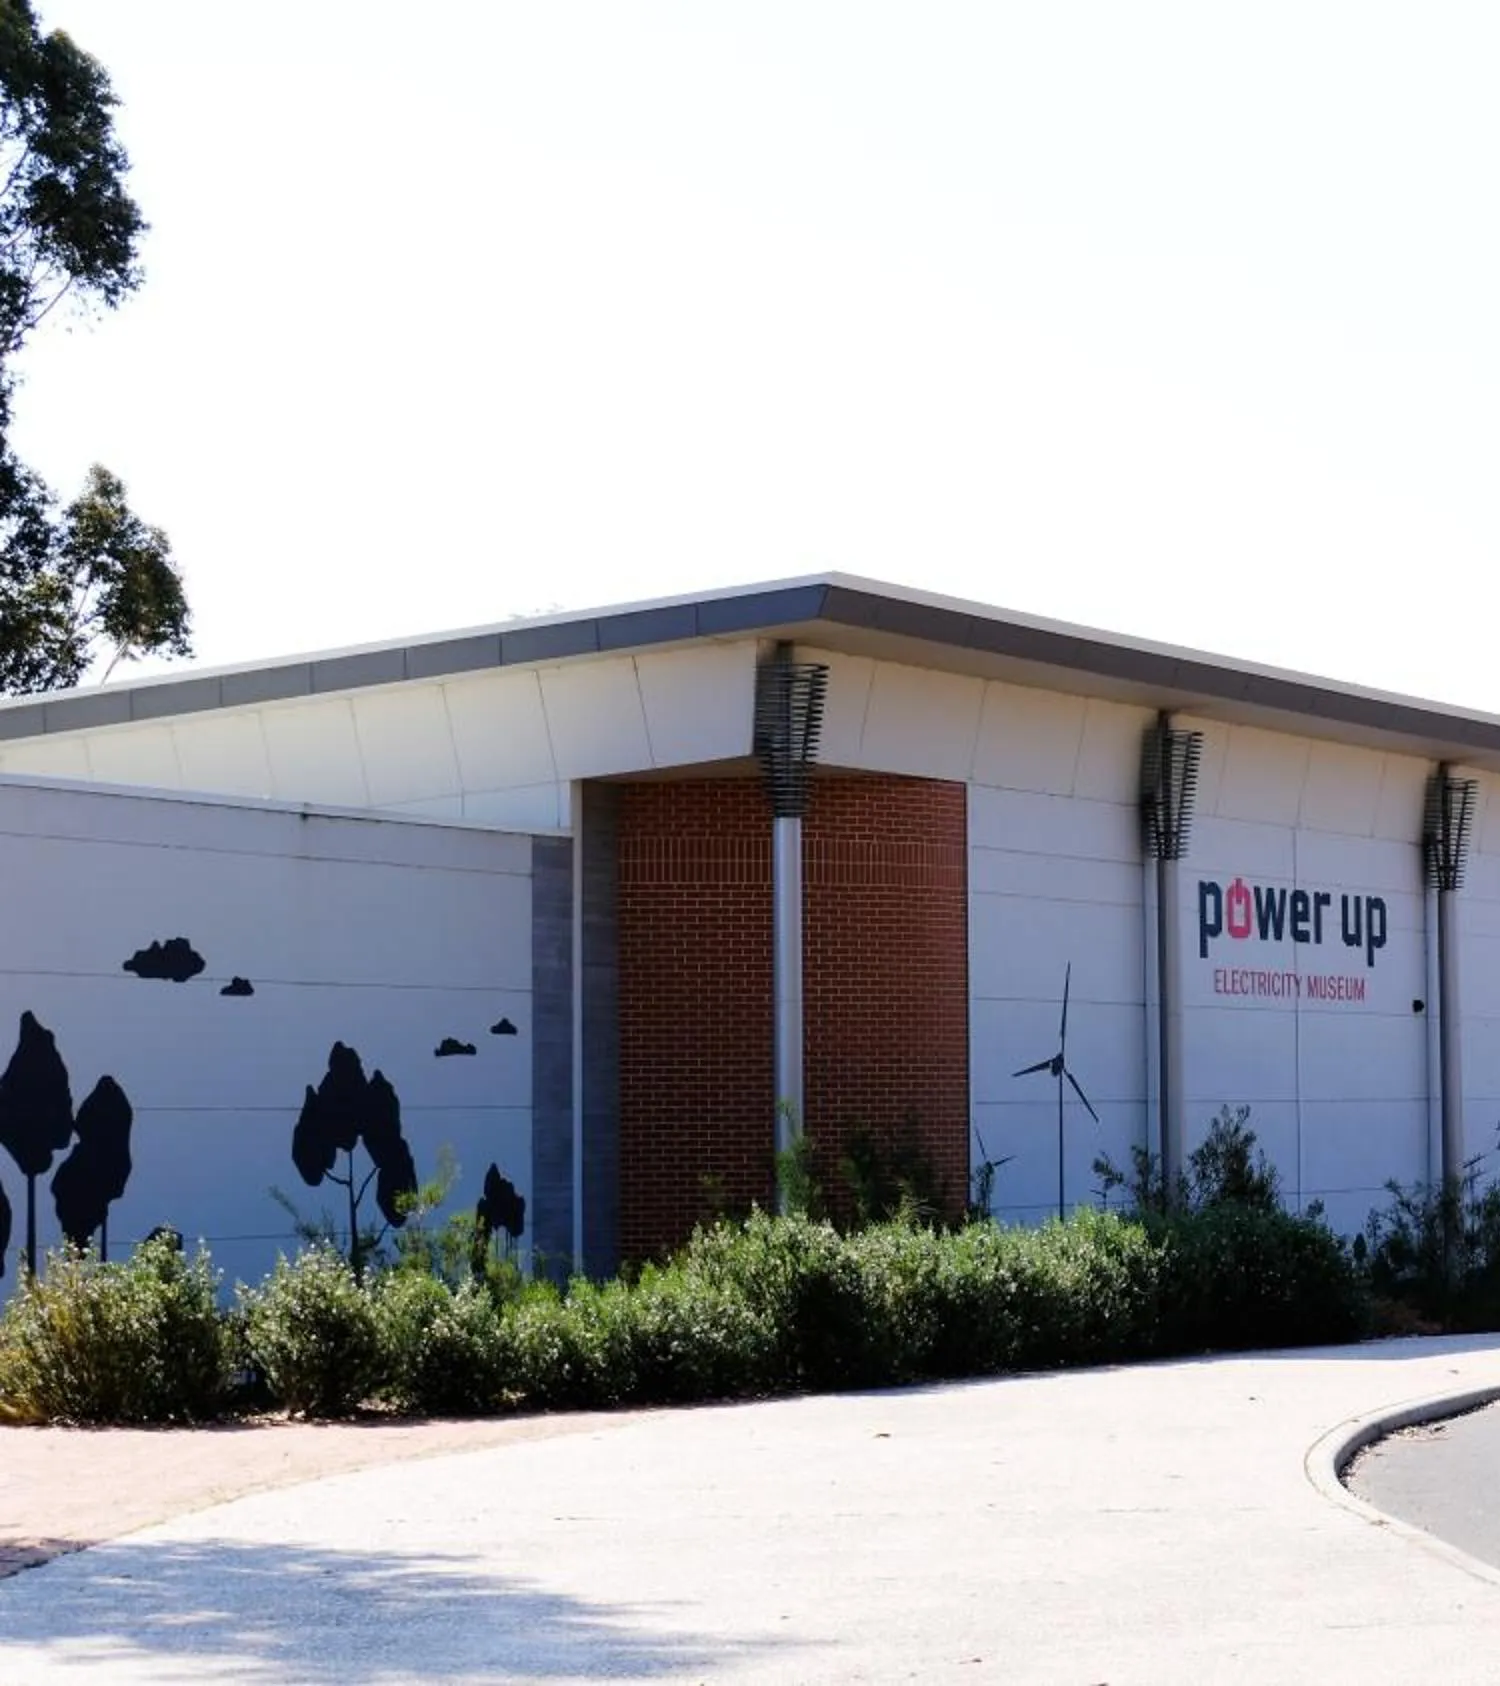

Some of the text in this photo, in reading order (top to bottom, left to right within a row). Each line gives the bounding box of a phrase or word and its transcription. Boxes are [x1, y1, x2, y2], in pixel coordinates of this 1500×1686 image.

[1198, 877, 1387, 967] power up
[1213, 968, 1366, 1001] ELECTRICITY MUSEUM
